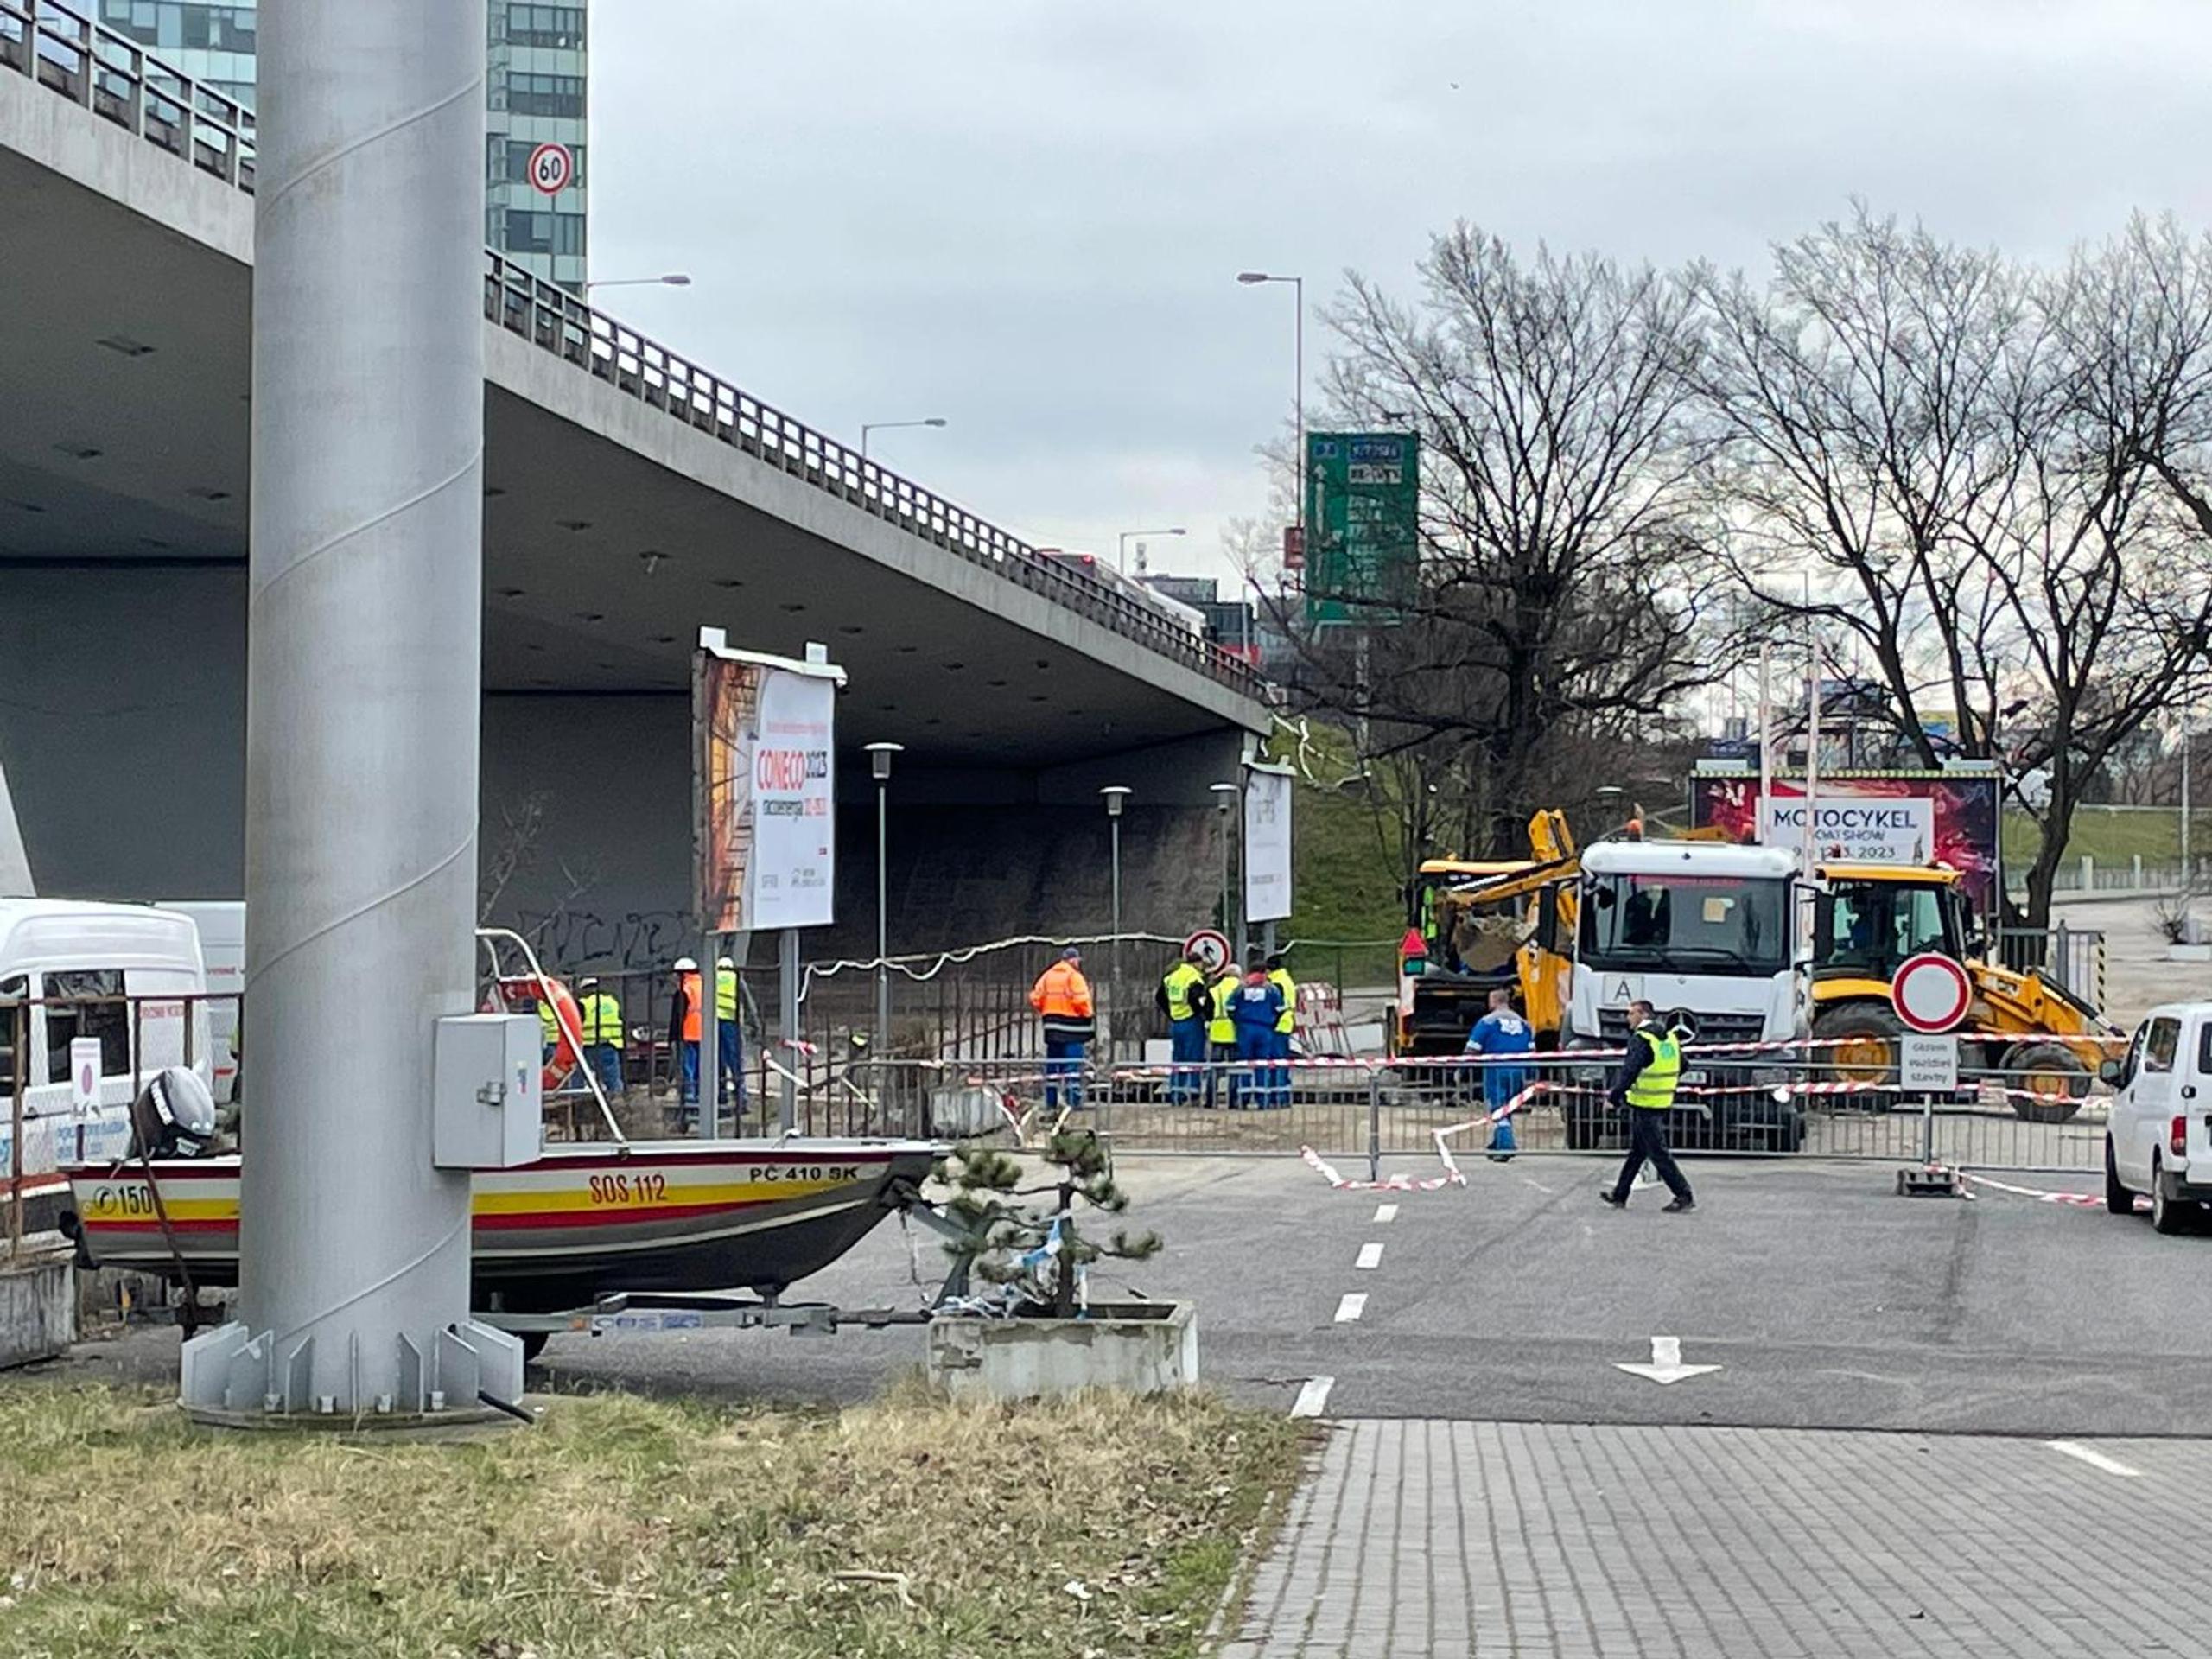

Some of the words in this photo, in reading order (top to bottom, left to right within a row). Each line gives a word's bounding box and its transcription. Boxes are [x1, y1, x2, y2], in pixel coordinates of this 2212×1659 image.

[539, 156, 562, 181] 60
[757, 749, 804, 790] CONECO
[1773, 809, 1918, 829] MOTOCYKEL
[1859, 846, 1896, 858] 2023
[1613, 980, 1632, 1001] A
[785, 1166, 821, 1181] 410
[828, 1166, 858, 1180] SK
[118, 1185, 153, 1214] 150
[590, 1175, 630, 1204] SOS
[634, 1173, 668, 1202] 112
